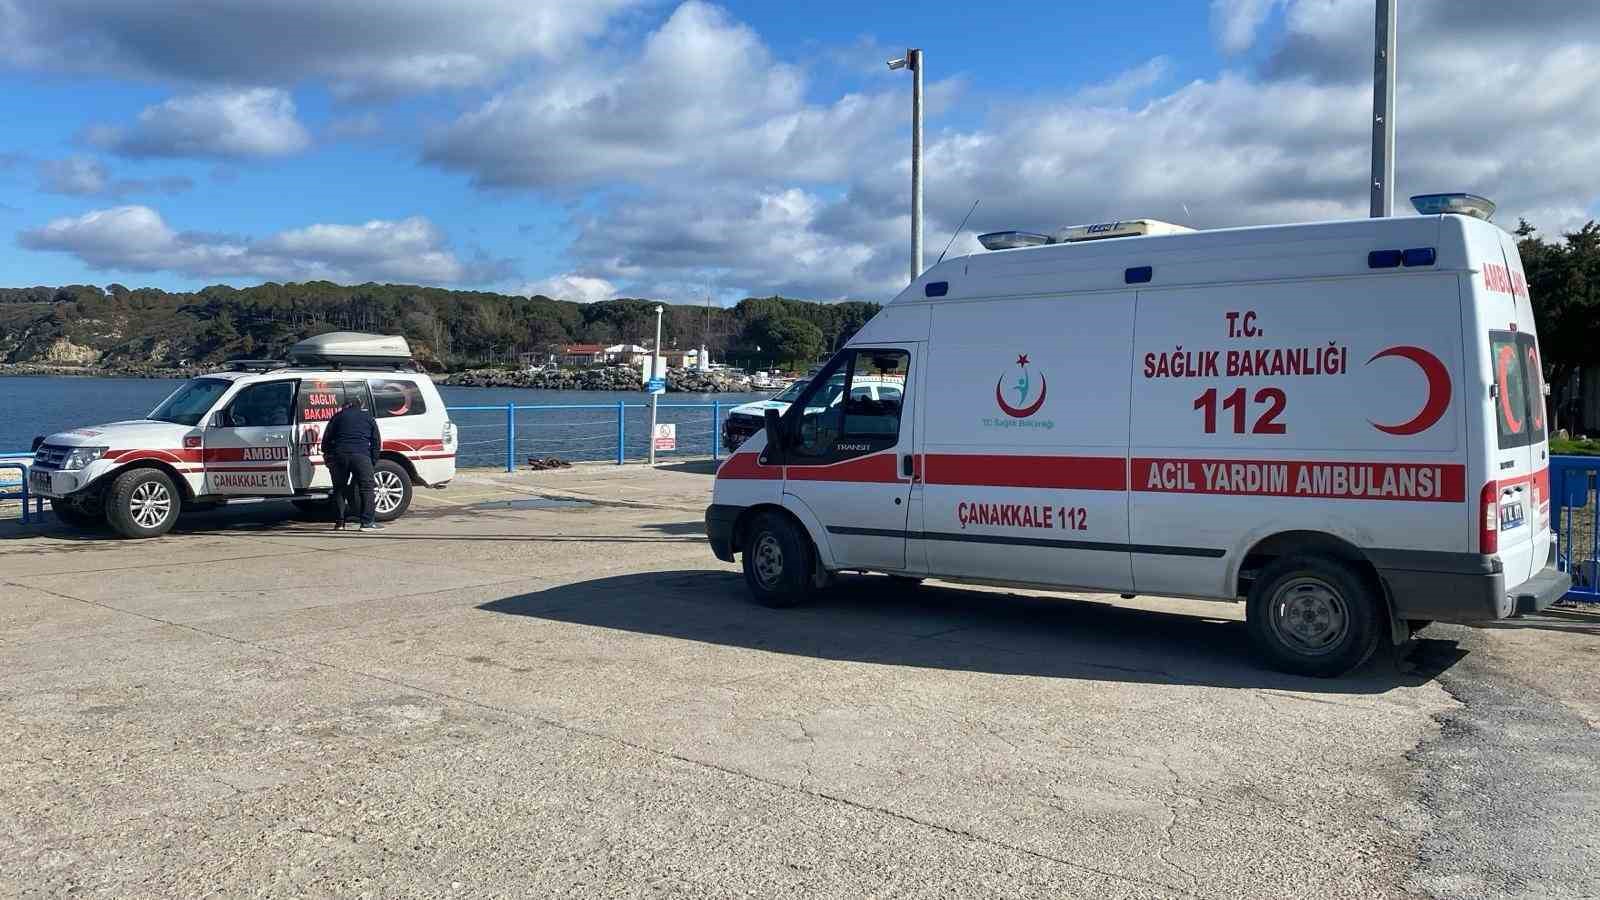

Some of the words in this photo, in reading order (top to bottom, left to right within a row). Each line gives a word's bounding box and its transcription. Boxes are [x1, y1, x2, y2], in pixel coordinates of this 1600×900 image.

[1226, 311, 1263, 337] T.C.
[1144, 345, 1219, 378] SAĞLIK
[1226, 341, 1347, 376] BAKANLIĞI
[1193, 387, 1287, 434] 112
[213, 471, 268, 490] ÇANAKKALE
[269, 471, 287, 488] 112
[1202, 463, 1288, 493] YARDIM
[1295, 465, 1441, 498] AMBULANSI
[958, 502, 1053, 529] ÇANAKKALE
[1058, 507, 1087, 530] 112
